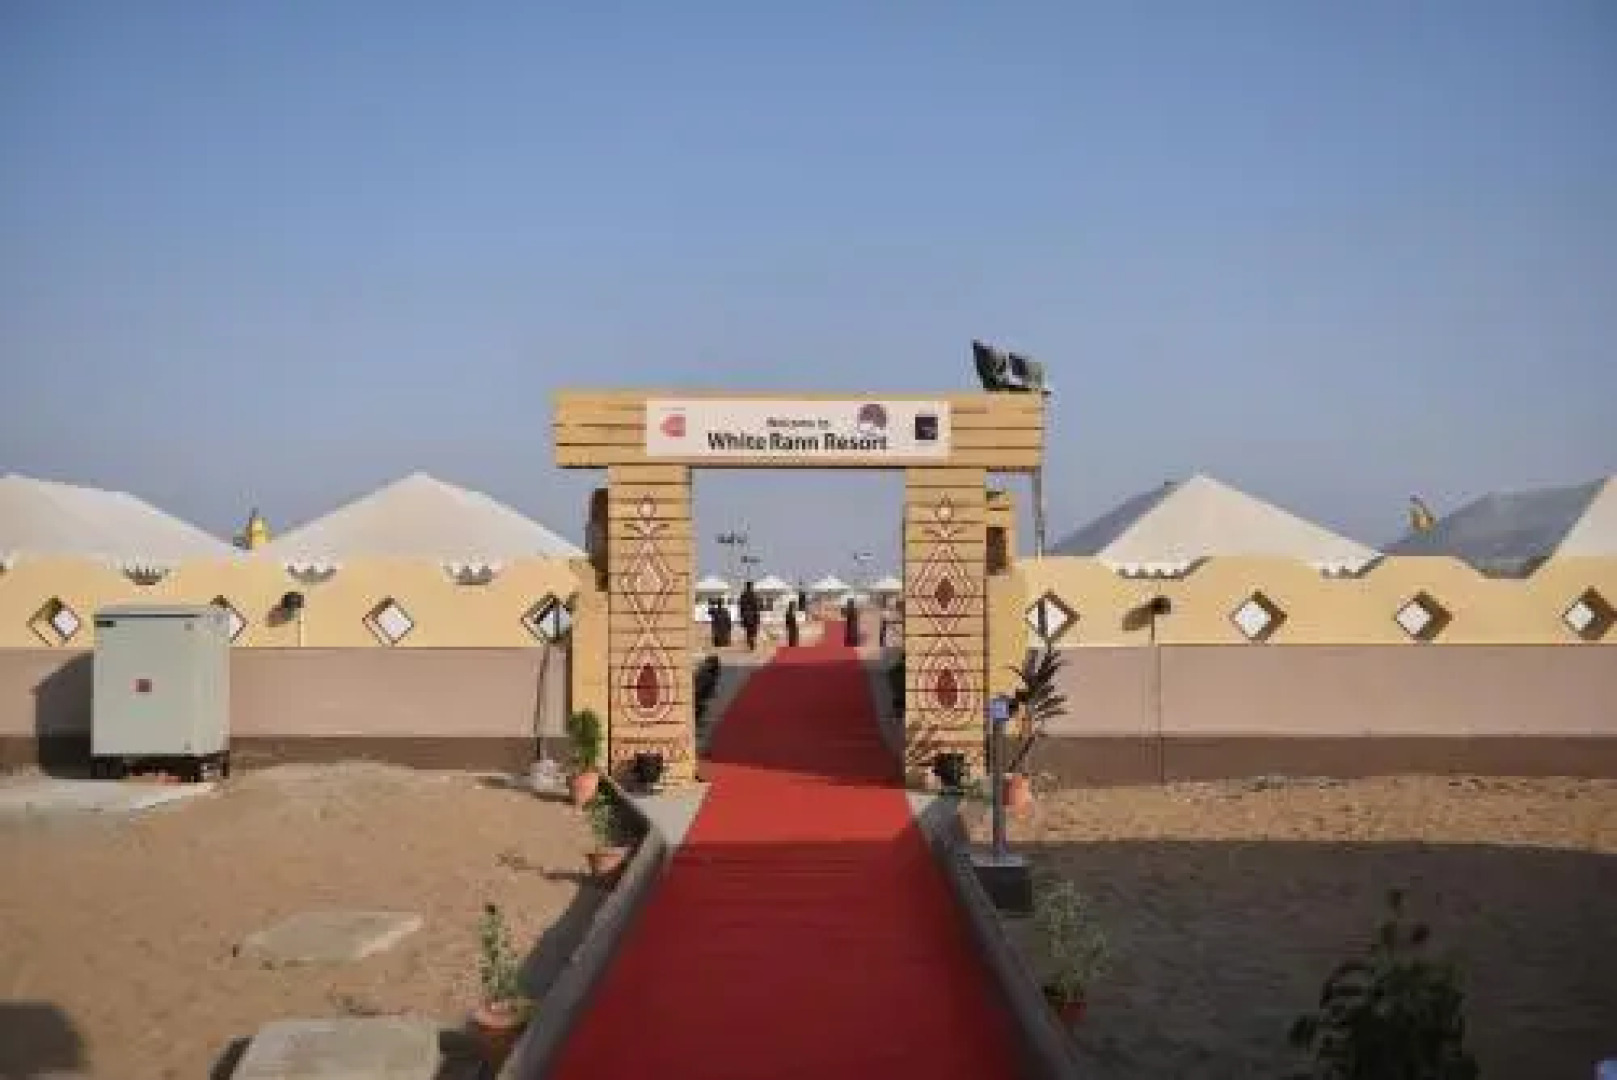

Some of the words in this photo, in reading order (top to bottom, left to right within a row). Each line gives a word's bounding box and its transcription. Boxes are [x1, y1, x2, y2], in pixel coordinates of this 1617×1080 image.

[707, 432, 767, 450] White
[769, 432, 819, 450] Rann
[824, 432, 887, 450] Resort
